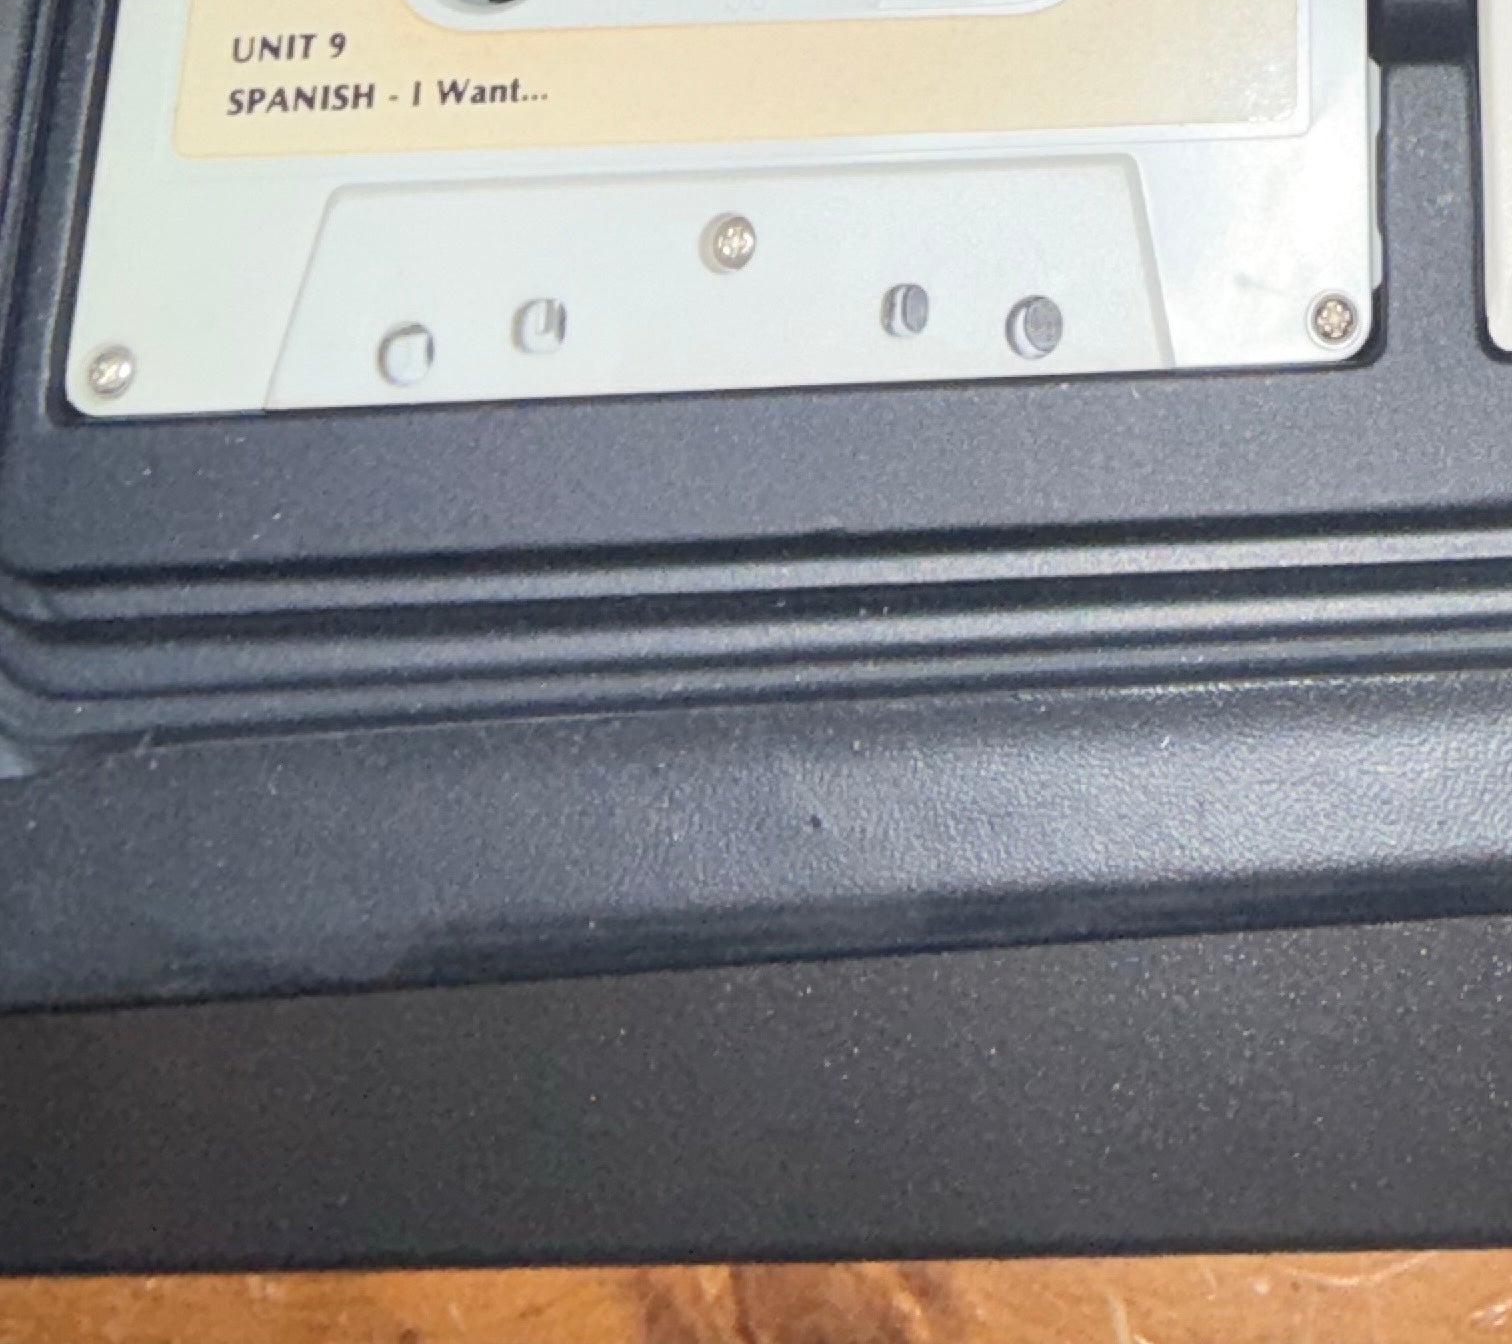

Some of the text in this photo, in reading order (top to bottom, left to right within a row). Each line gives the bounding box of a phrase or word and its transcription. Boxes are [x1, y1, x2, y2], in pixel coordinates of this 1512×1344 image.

[233, 33, 345, 63] UNIT 9
[228, 84, 375, 115] SPANISH
[413, 81, 421, 106] I
[437, 78, 547, 105] Want...
